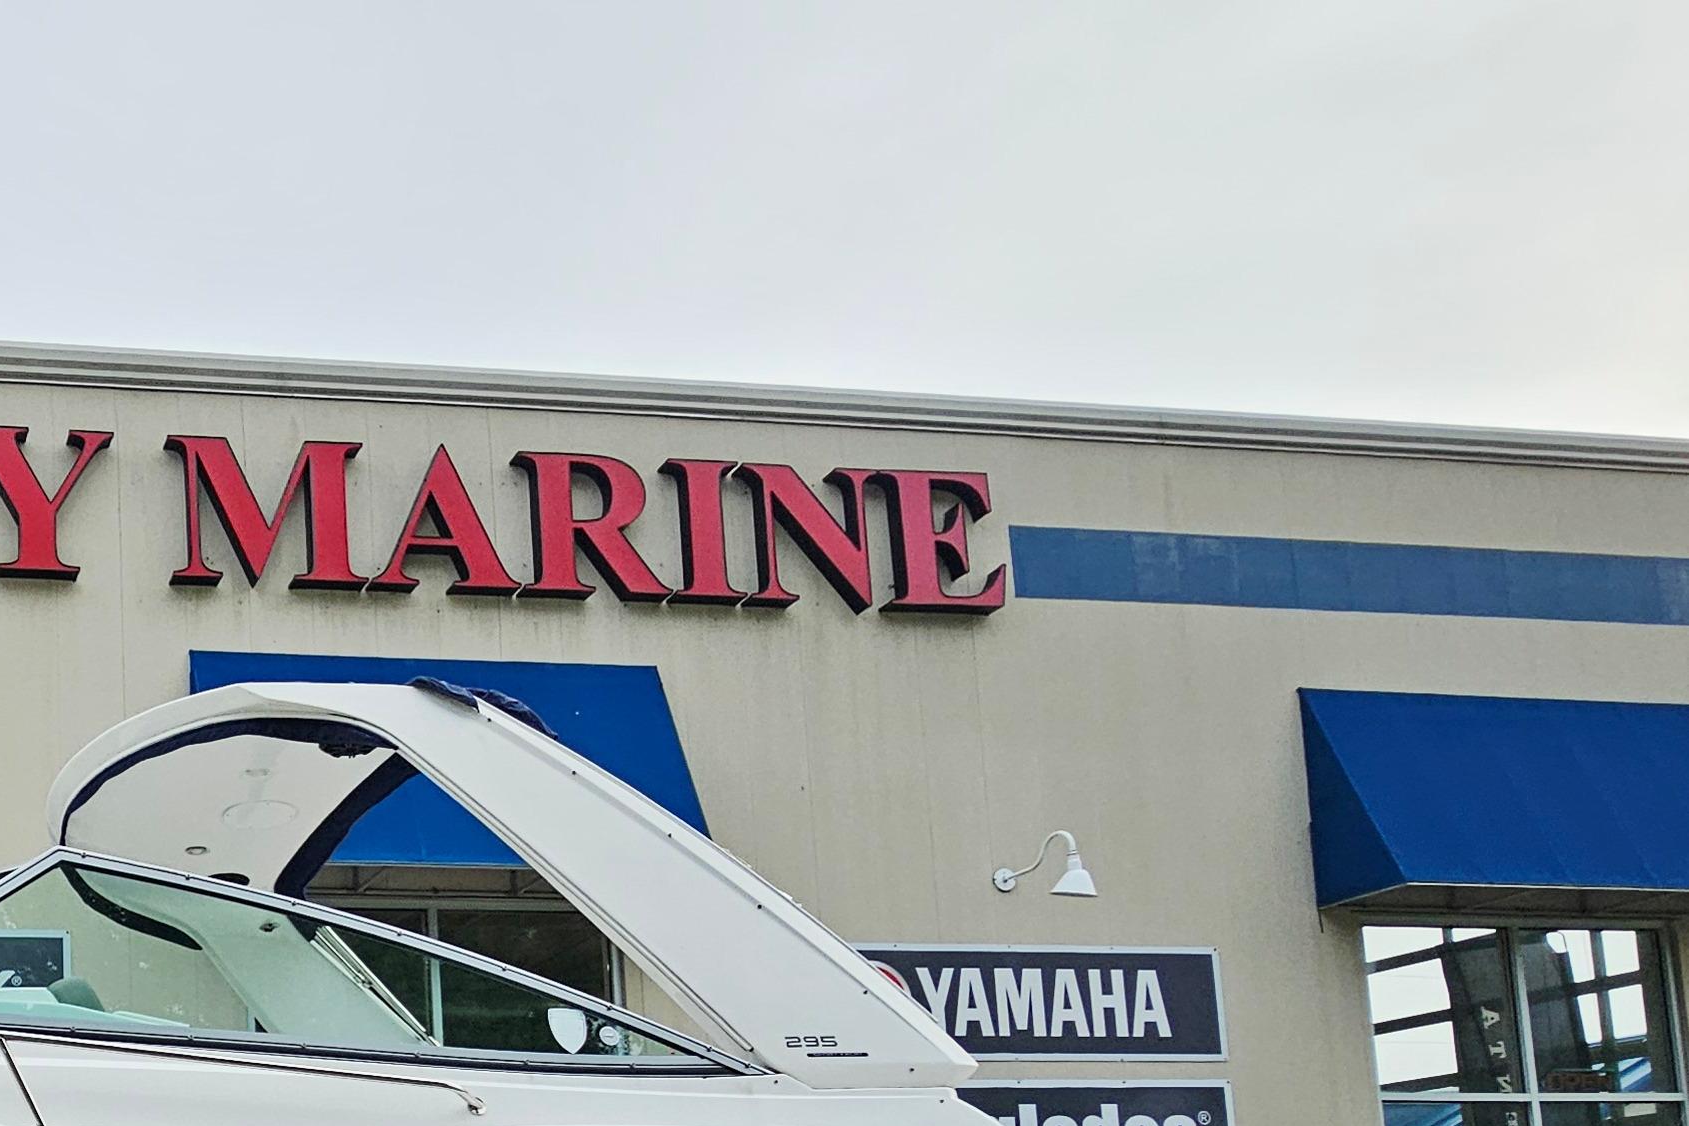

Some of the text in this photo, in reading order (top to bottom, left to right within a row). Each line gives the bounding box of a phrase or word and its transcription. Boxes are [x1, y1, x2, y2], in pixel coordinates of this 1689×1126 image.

[163, 434, 1007, 616] MARINE
[915, 967, 1173, 1038] YAMAHA
[784, 1035, 838, 1048] 295
